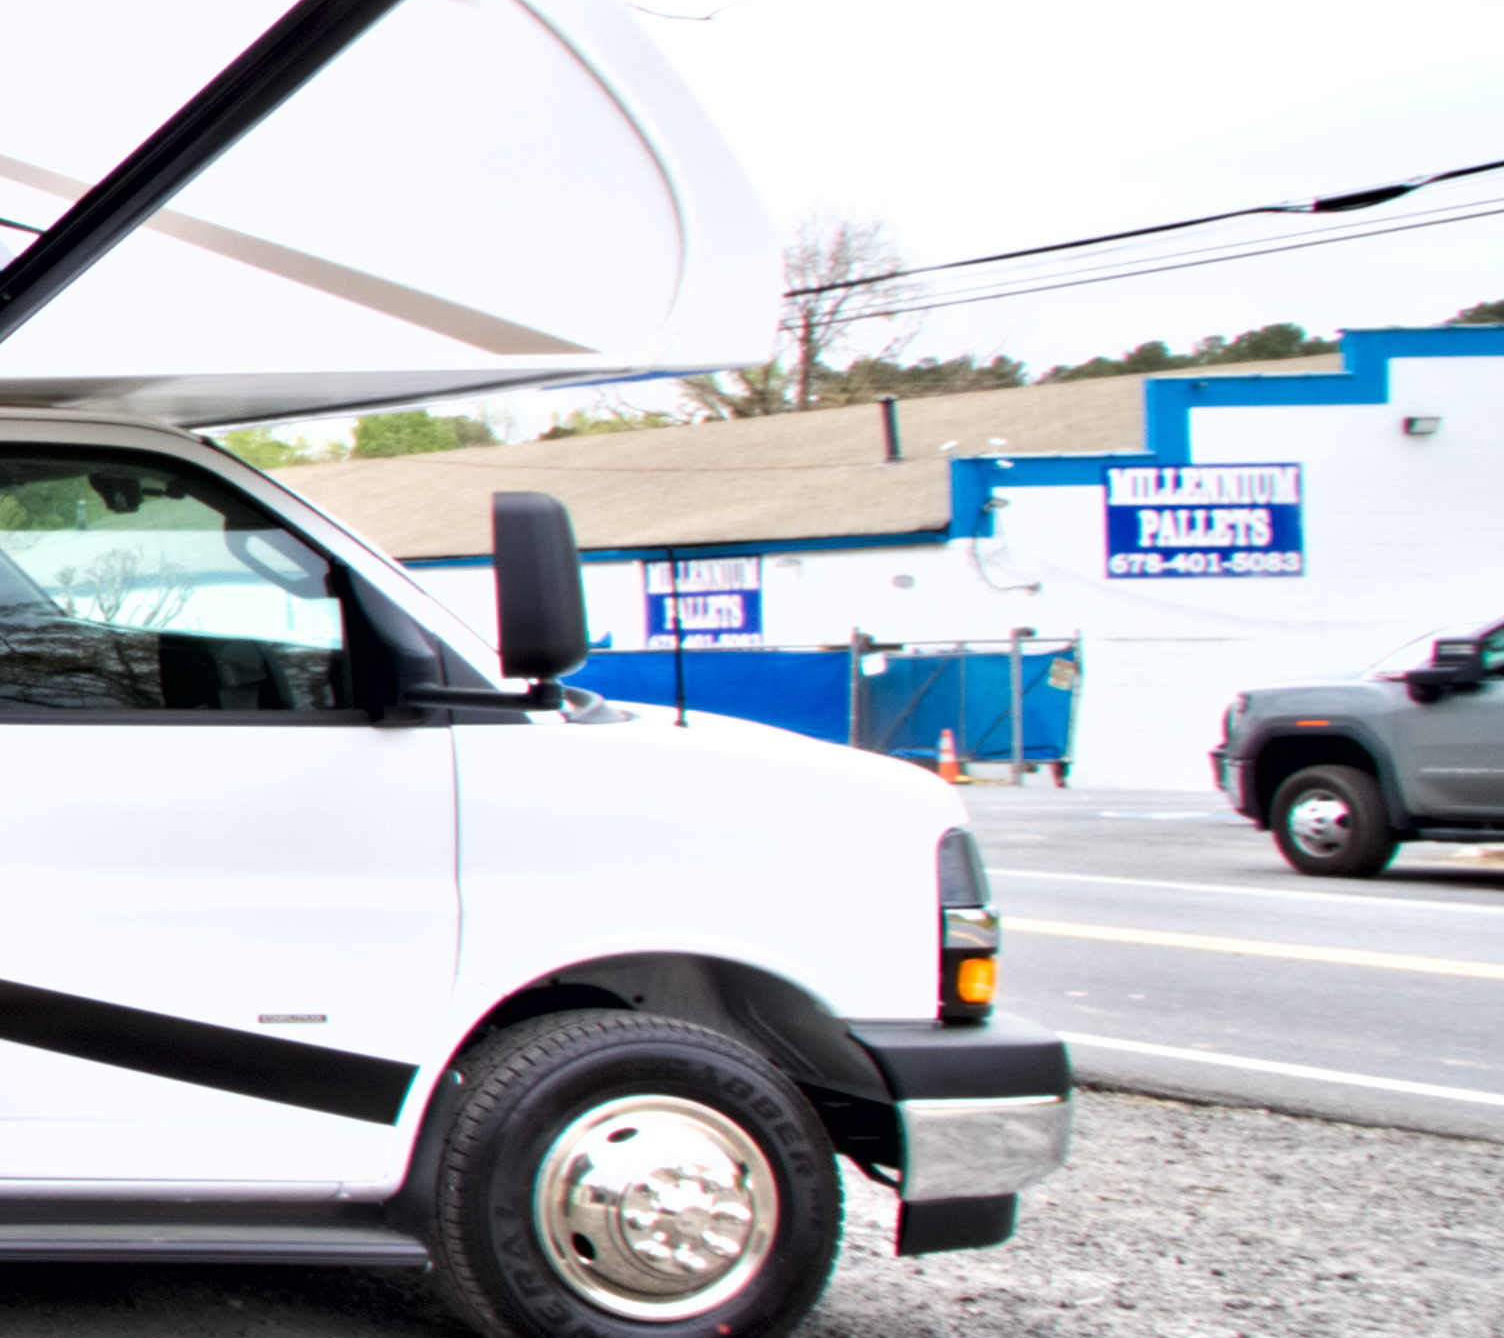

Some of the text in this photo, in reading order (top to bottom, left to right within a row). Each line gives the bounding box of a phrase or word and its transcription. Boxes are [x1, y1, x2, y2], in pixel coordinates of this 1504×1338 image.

[1108, 467, 1300, 505] MILLENNIUM
[1138, 509, 1272, 547] PALLETS
[1108, 552, 1303, 574] 678-401-5083
